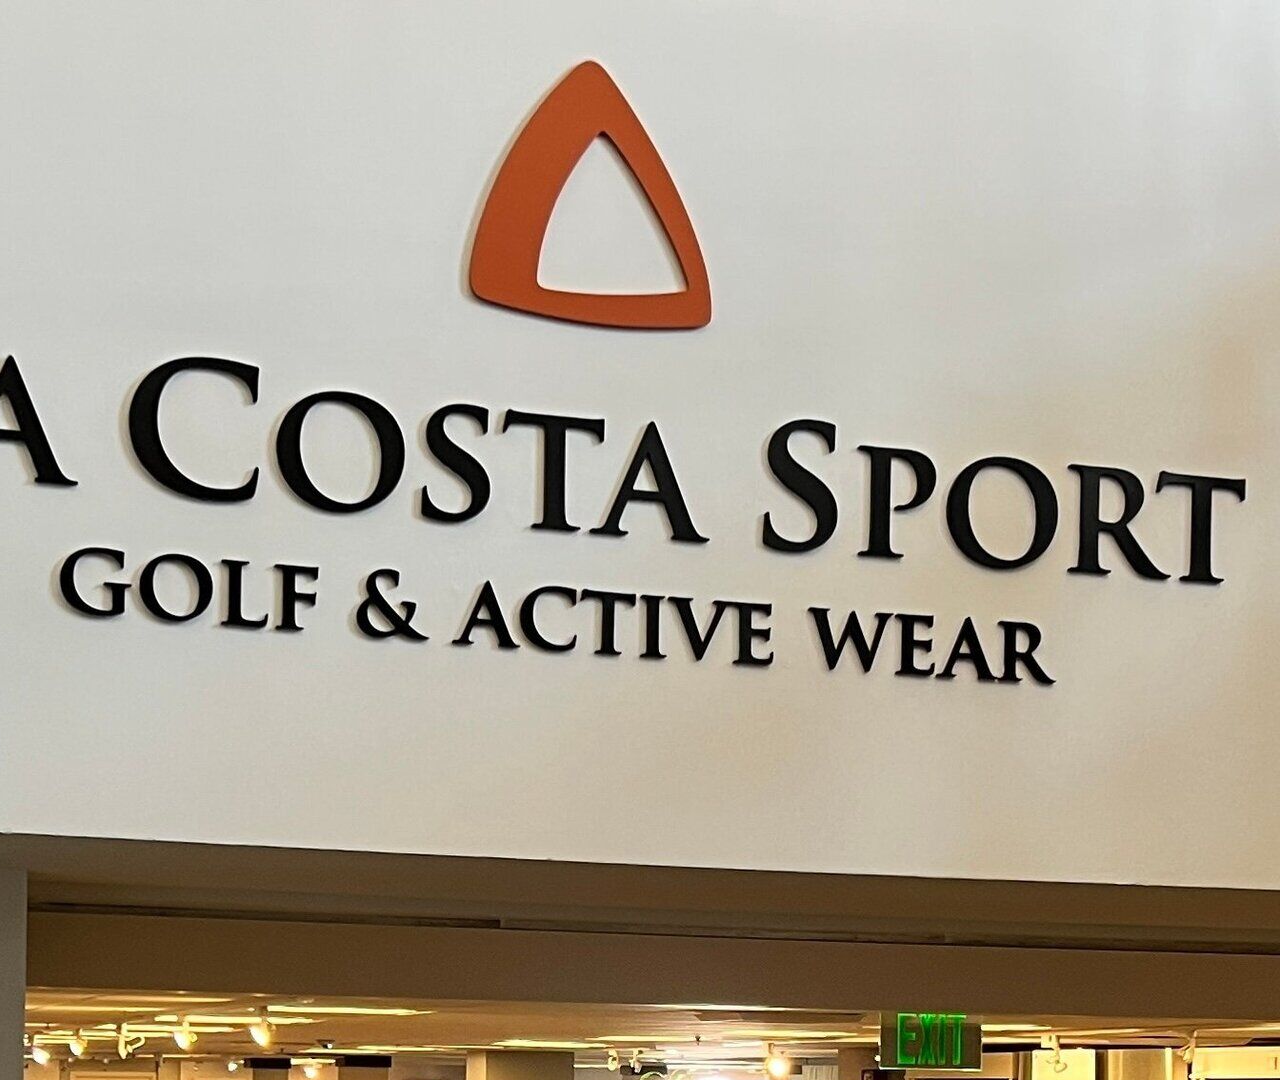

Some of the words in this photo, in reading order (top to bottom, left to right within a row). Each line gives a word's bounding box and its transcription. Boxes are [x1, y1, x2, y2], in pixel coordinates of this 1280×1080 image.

[127, 355, 711, 544] COSTA
[762, 418, 1248, 585] SPORT
[59, 546, 320, 632] GOLF
[355, 568, 430, 641] &
[451, 579, 775, 666] ACTIVE
[807, 606, 1057, 685] WEAR
[897, 1013, 967, 1065] EXIT
